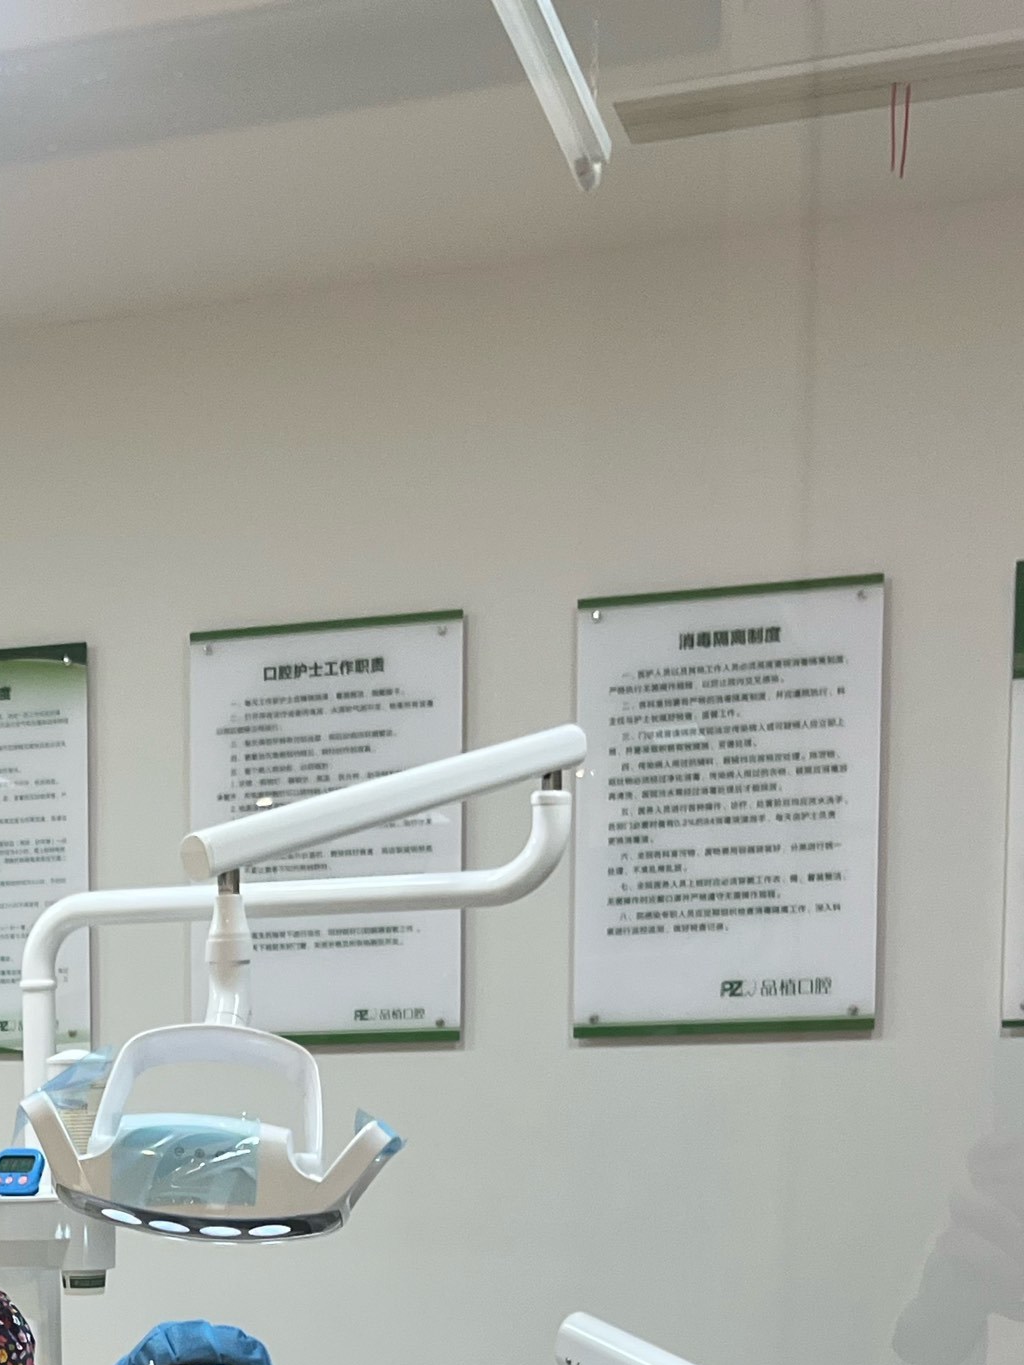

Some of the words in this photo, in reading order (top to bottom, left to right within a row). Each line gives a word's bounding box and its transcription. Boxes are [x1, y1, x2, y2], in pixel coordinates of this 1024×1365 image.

[679, 626, 782, 651] 消毒隔离制度
[263, 657, 385, 681] 口腔护士工作职责
